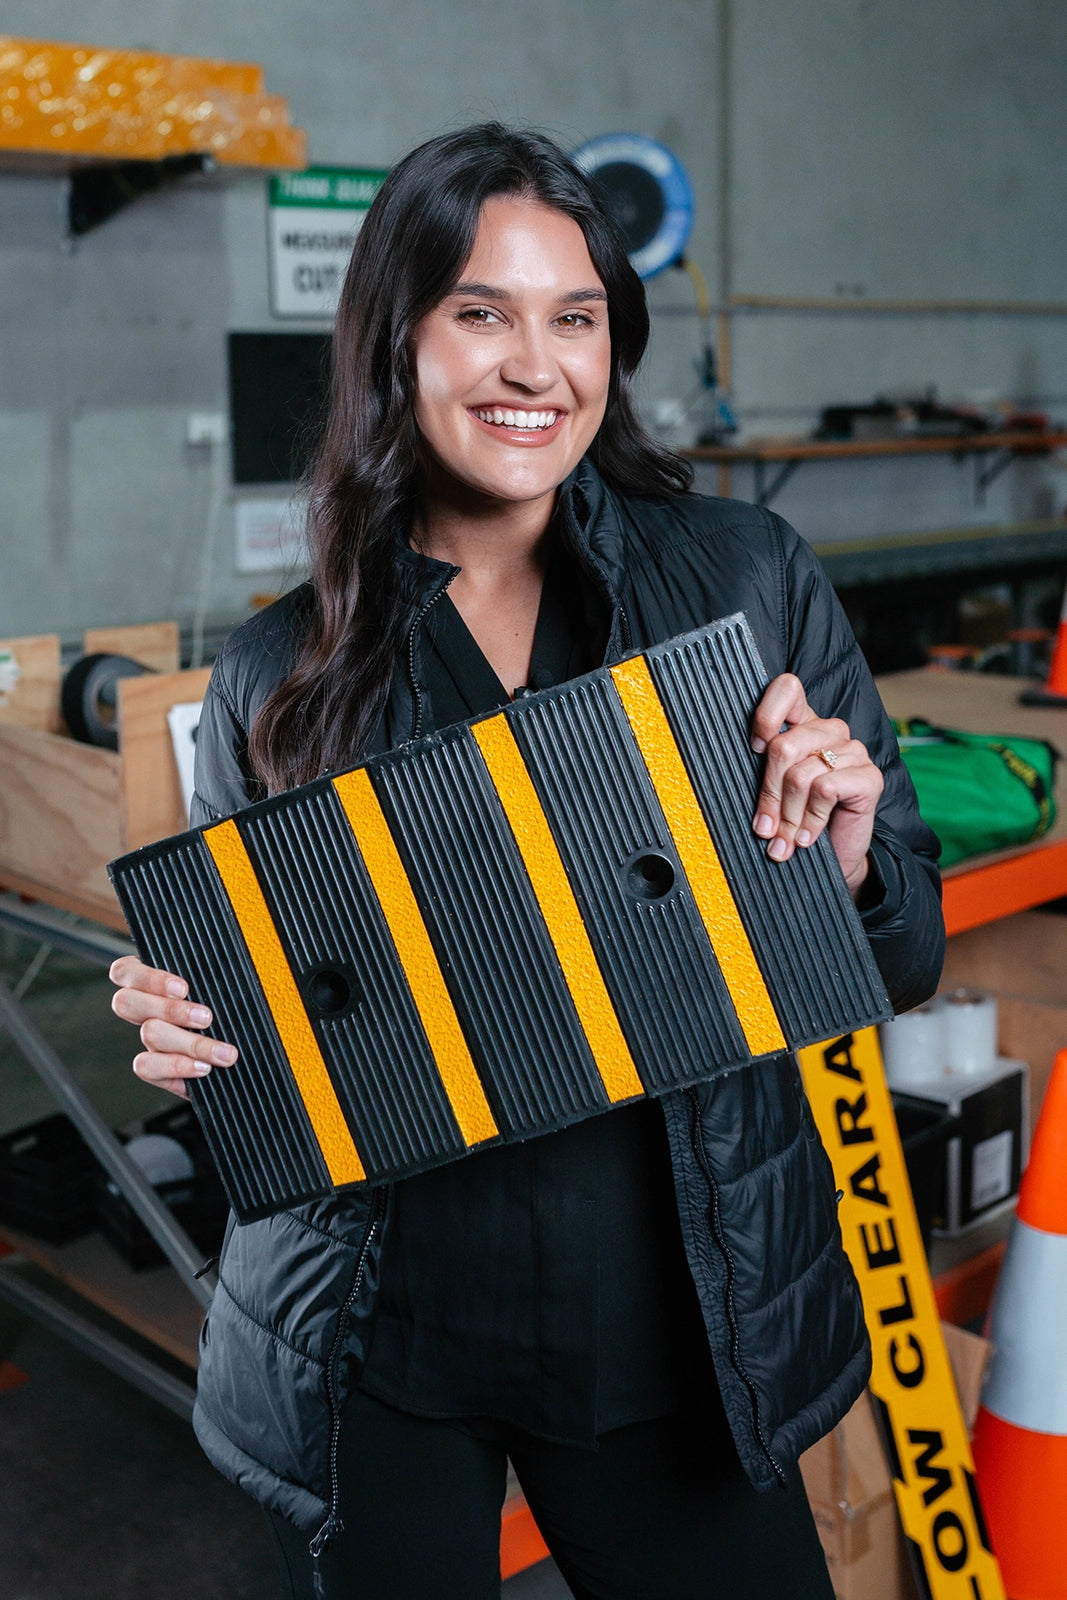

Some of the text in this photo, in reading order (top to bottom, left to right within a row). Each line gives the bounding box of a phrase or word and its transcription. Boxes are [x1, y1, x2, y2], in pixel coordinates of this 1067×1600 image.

[294, 266, 338, 291] CUT
[824, 1032, 983, 1600] OW CLEARA
